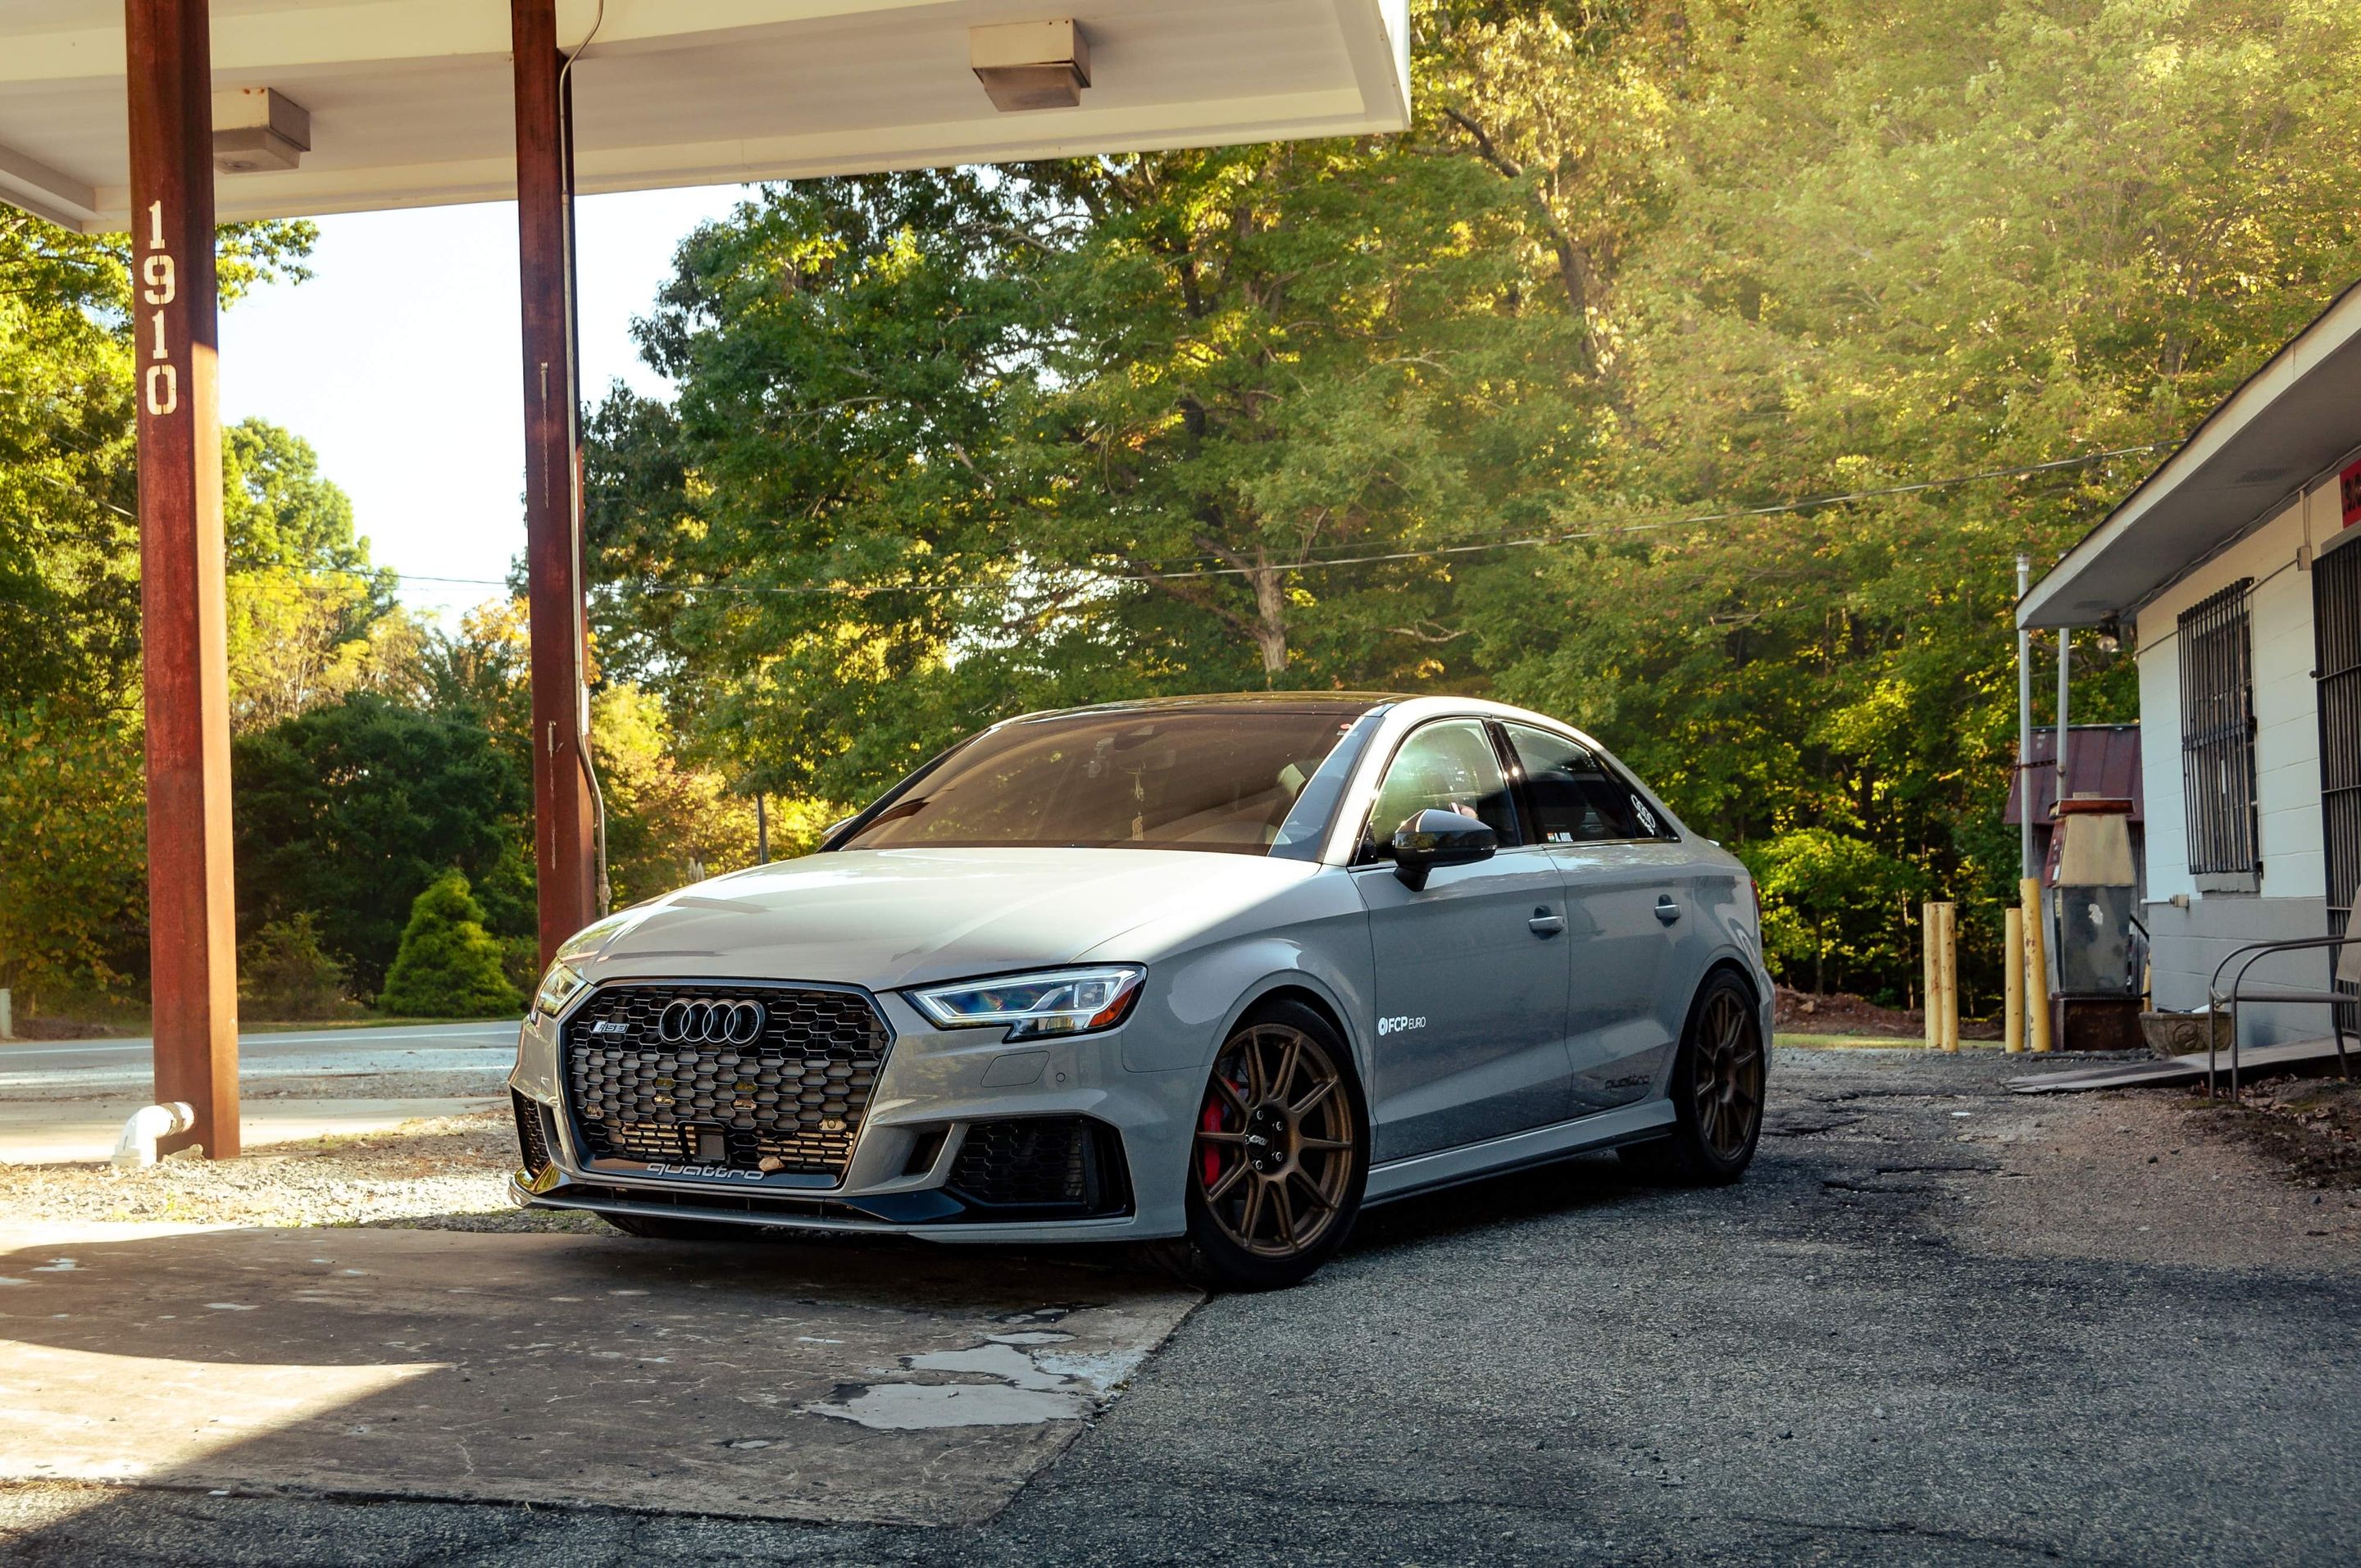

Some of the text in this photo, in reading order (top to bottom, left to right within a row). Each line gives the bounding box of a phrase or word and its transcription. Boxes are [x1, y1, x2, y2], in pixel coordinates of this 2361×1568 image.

[143, 200, 178, 416] 1910
[1388, 1016, 1426, 1033] FCP EURO
[646, 1162, 765, 1180] quattro
